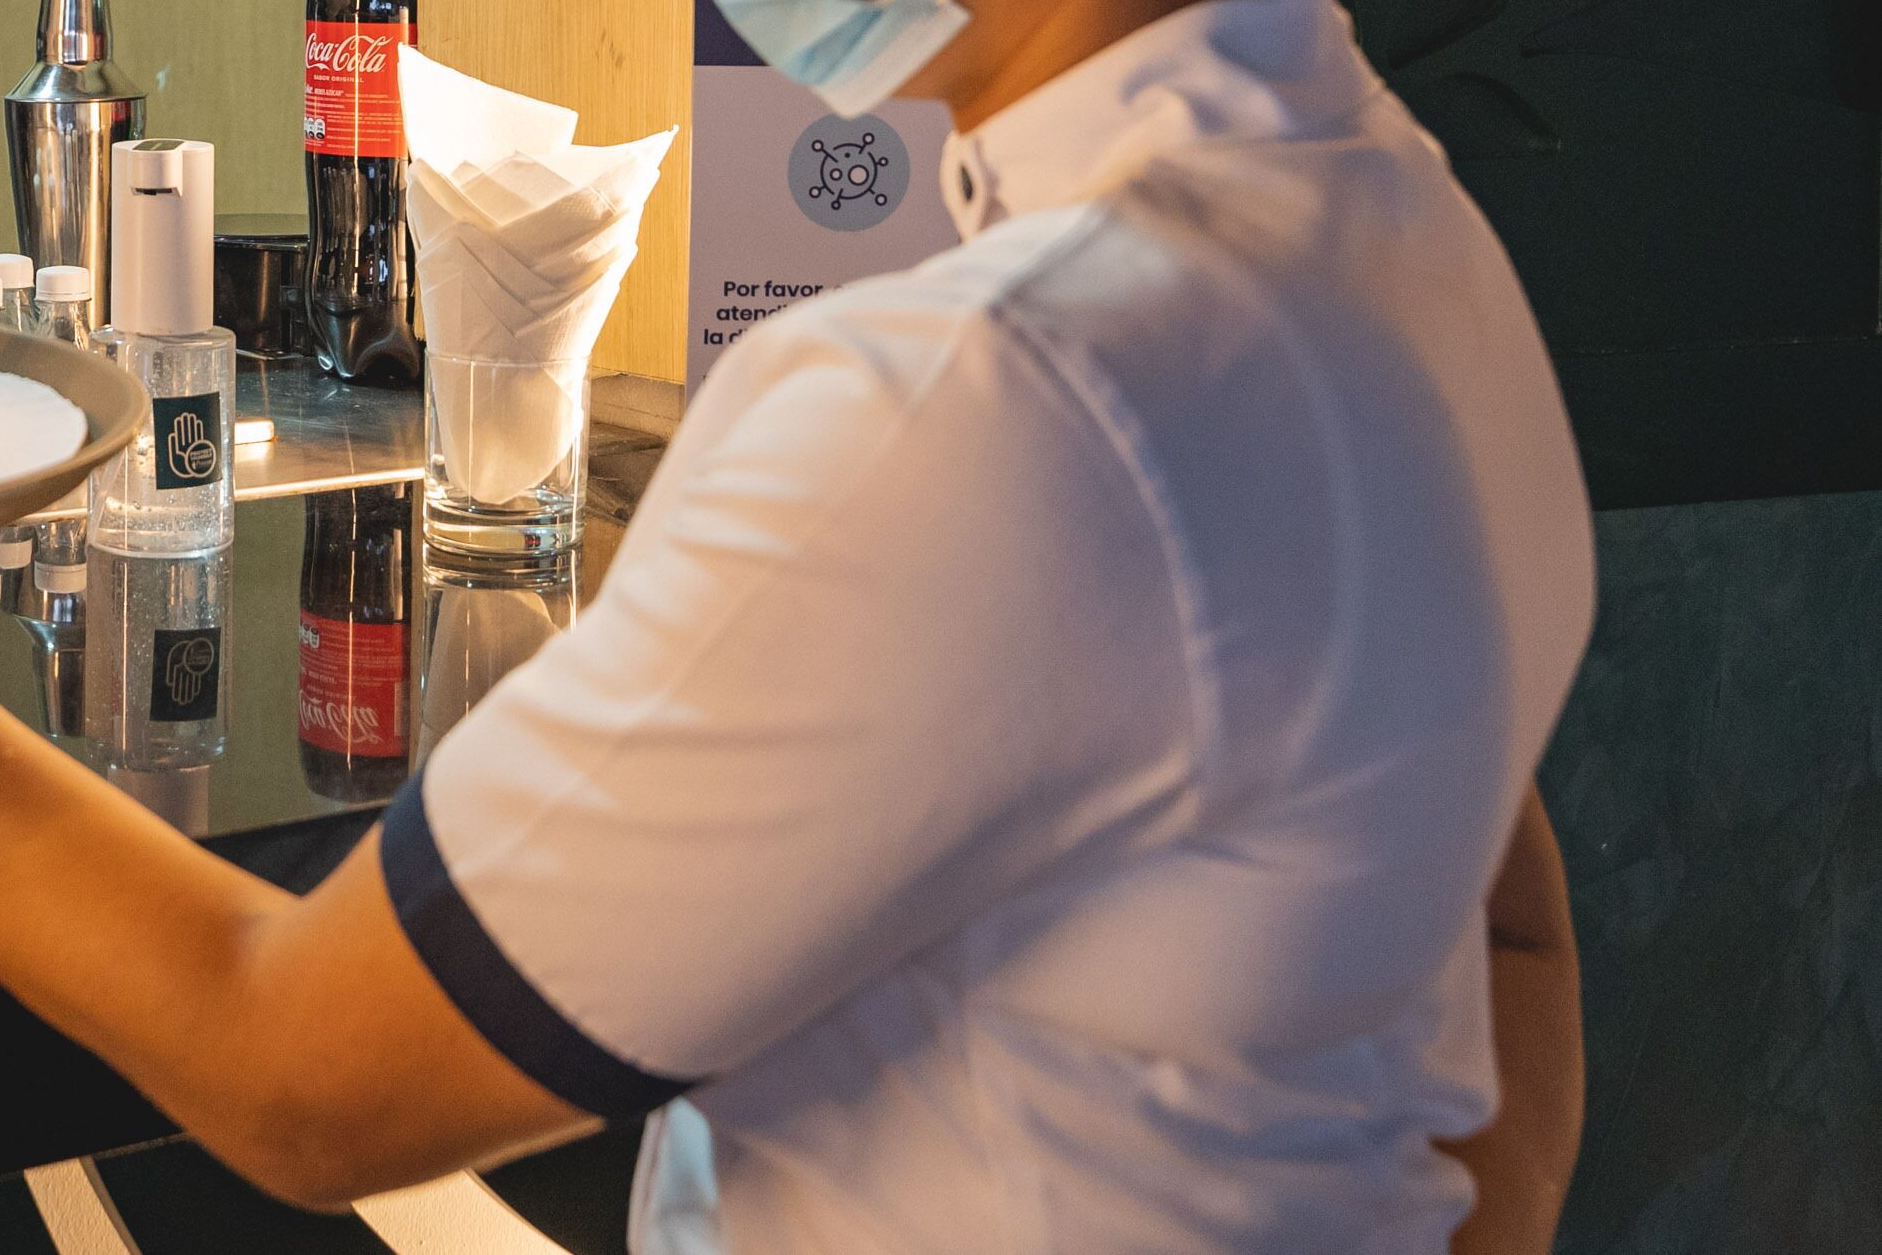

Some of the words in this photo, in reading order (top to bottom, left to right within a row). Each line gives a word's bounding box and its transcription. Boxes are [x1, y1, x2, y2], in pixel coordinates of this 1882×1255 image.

[305, 33, 393, 73] Coca-Cola
[724, 281, 759, 296] Por
[704, 329, 723, 344] la
